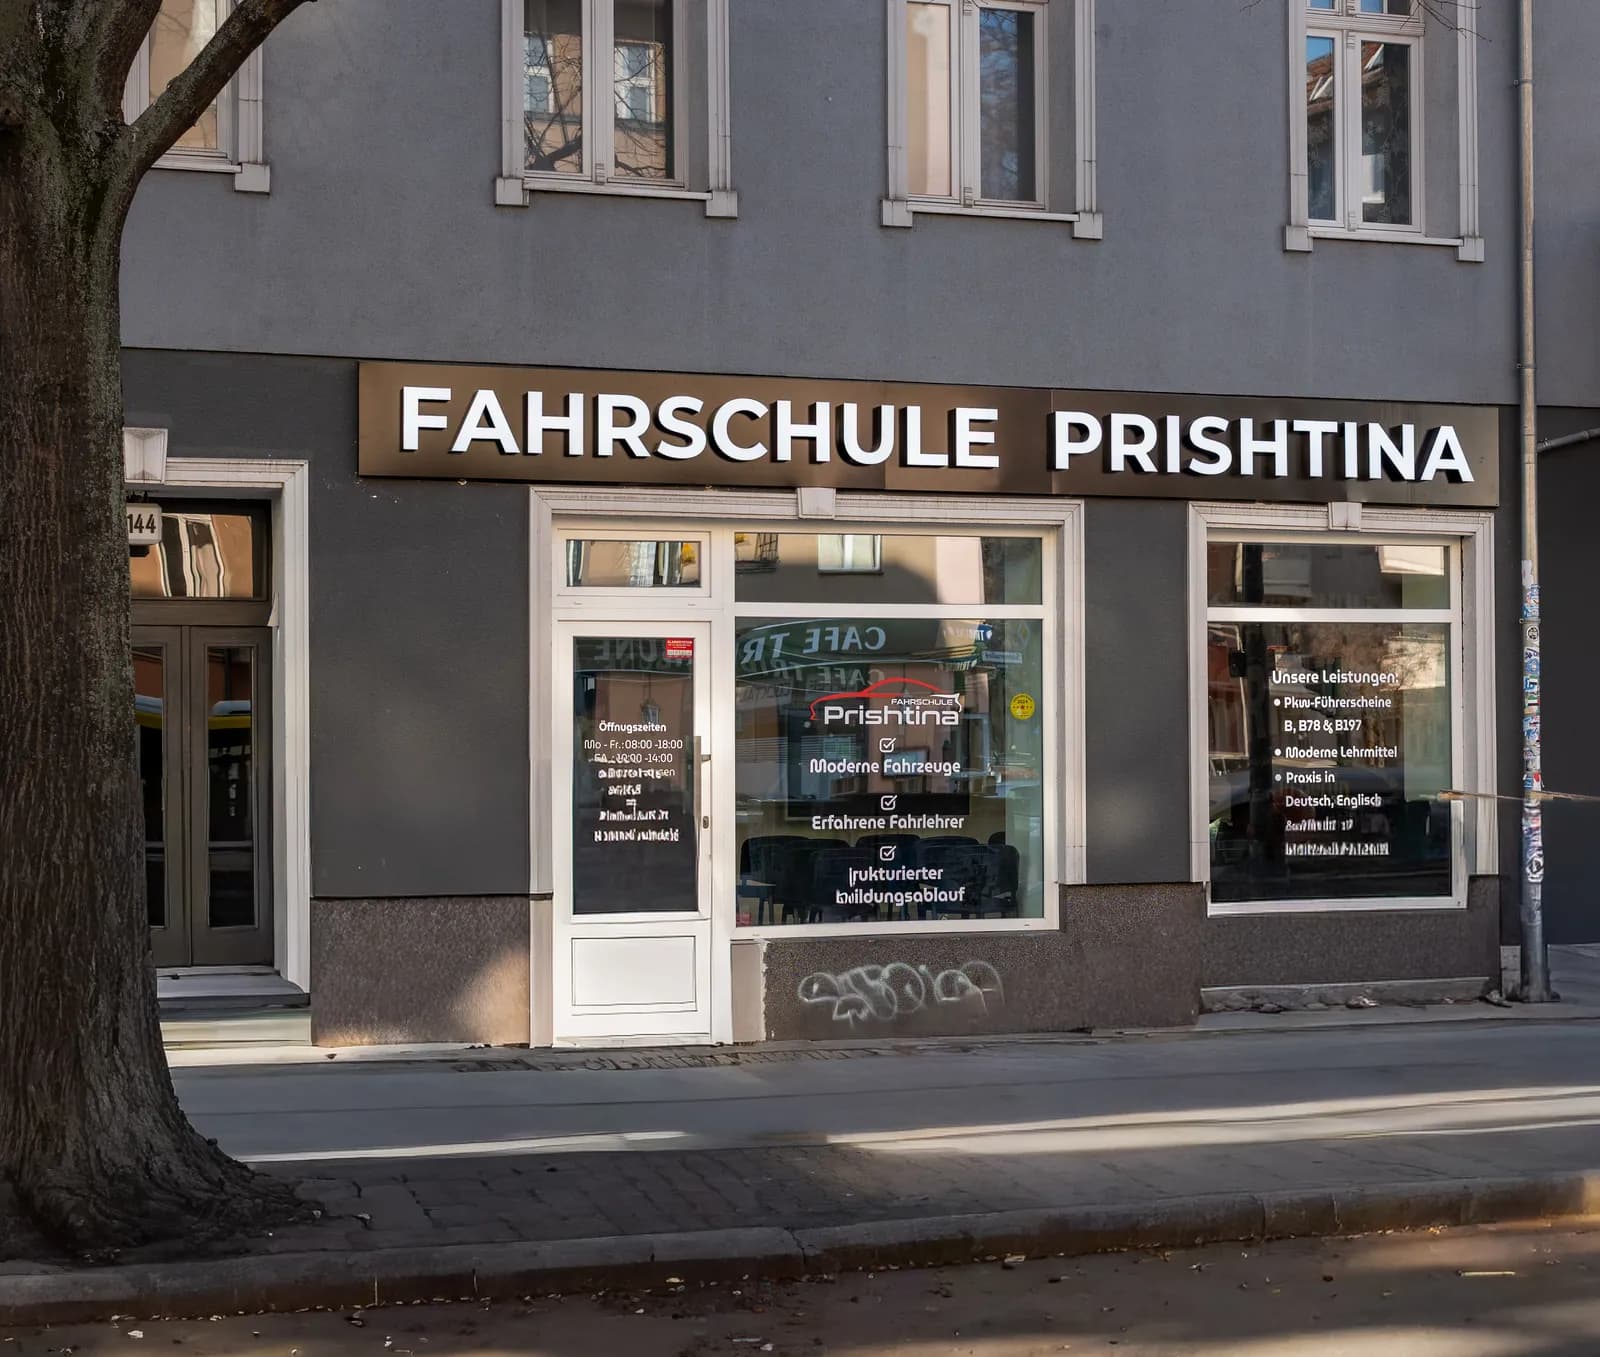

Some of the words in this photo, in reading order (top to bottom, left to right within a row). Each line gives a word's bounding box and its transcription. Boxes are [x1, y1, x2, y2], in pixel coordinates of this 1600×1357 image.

[402, 386, 1000, 468] FAHRSCHULE
[1055, 410, 1475, 482] PRISHTINA
[127, 513, 157, 534] 144
[1272, 670, 1319, 684] Unsere
[1322, 669, 1400, 687] Leistungen:
[1284, 695, 1392, 709] Pkw-Führerscheine
[824, 705, 959, 725] Prishtina
[1284, 719, 1297, 733] B,
[1299, 719, 1321, 732] B78
[1322, 719, 1334, 734] &
[1335, 719, 1362, 732] B197
[584, 740, 602, 749] Mo
[1285, 746, 1338, 759] Moderne
[1340, 745, 1398, 758] Lehrmittel
[810, 758, 879, 773] Moderne
[883, 758, 961, 777] Fahrzeuge
[1286, 770, 1322, 784] Praxis
[1324, 770, 1336, 783] in
[1285, 794, 1335, 809] Deutsch,
[812, 815, 886, 830] Erfahrene
[889, 814, 965, 829] Fahrlehrer
